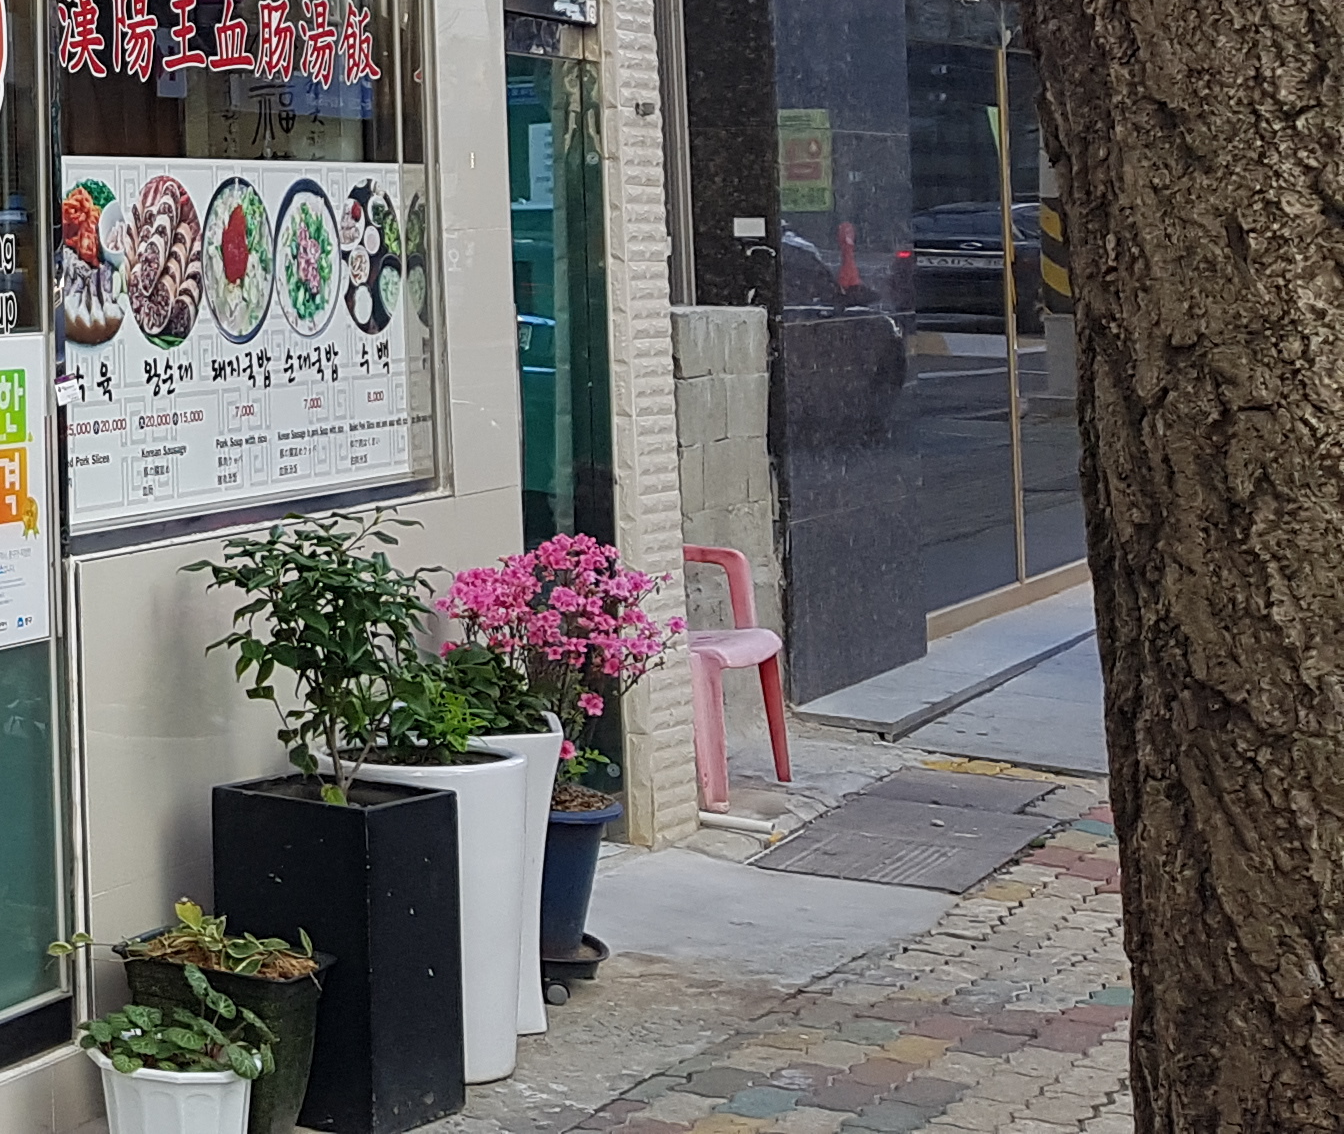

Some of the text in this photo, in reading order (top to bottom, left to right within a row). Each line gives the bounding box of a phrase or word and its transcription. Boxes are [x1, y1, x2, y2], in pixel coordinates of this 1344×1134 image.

[144, 357, 193, 397] 왕순대
[211, 347, 272, 389] 돼지국밥
[283, 342, 339, 384] 순대국밥
[235, 404, 255, 418] 7,000
[303, 397, 322, 411] 7,000
